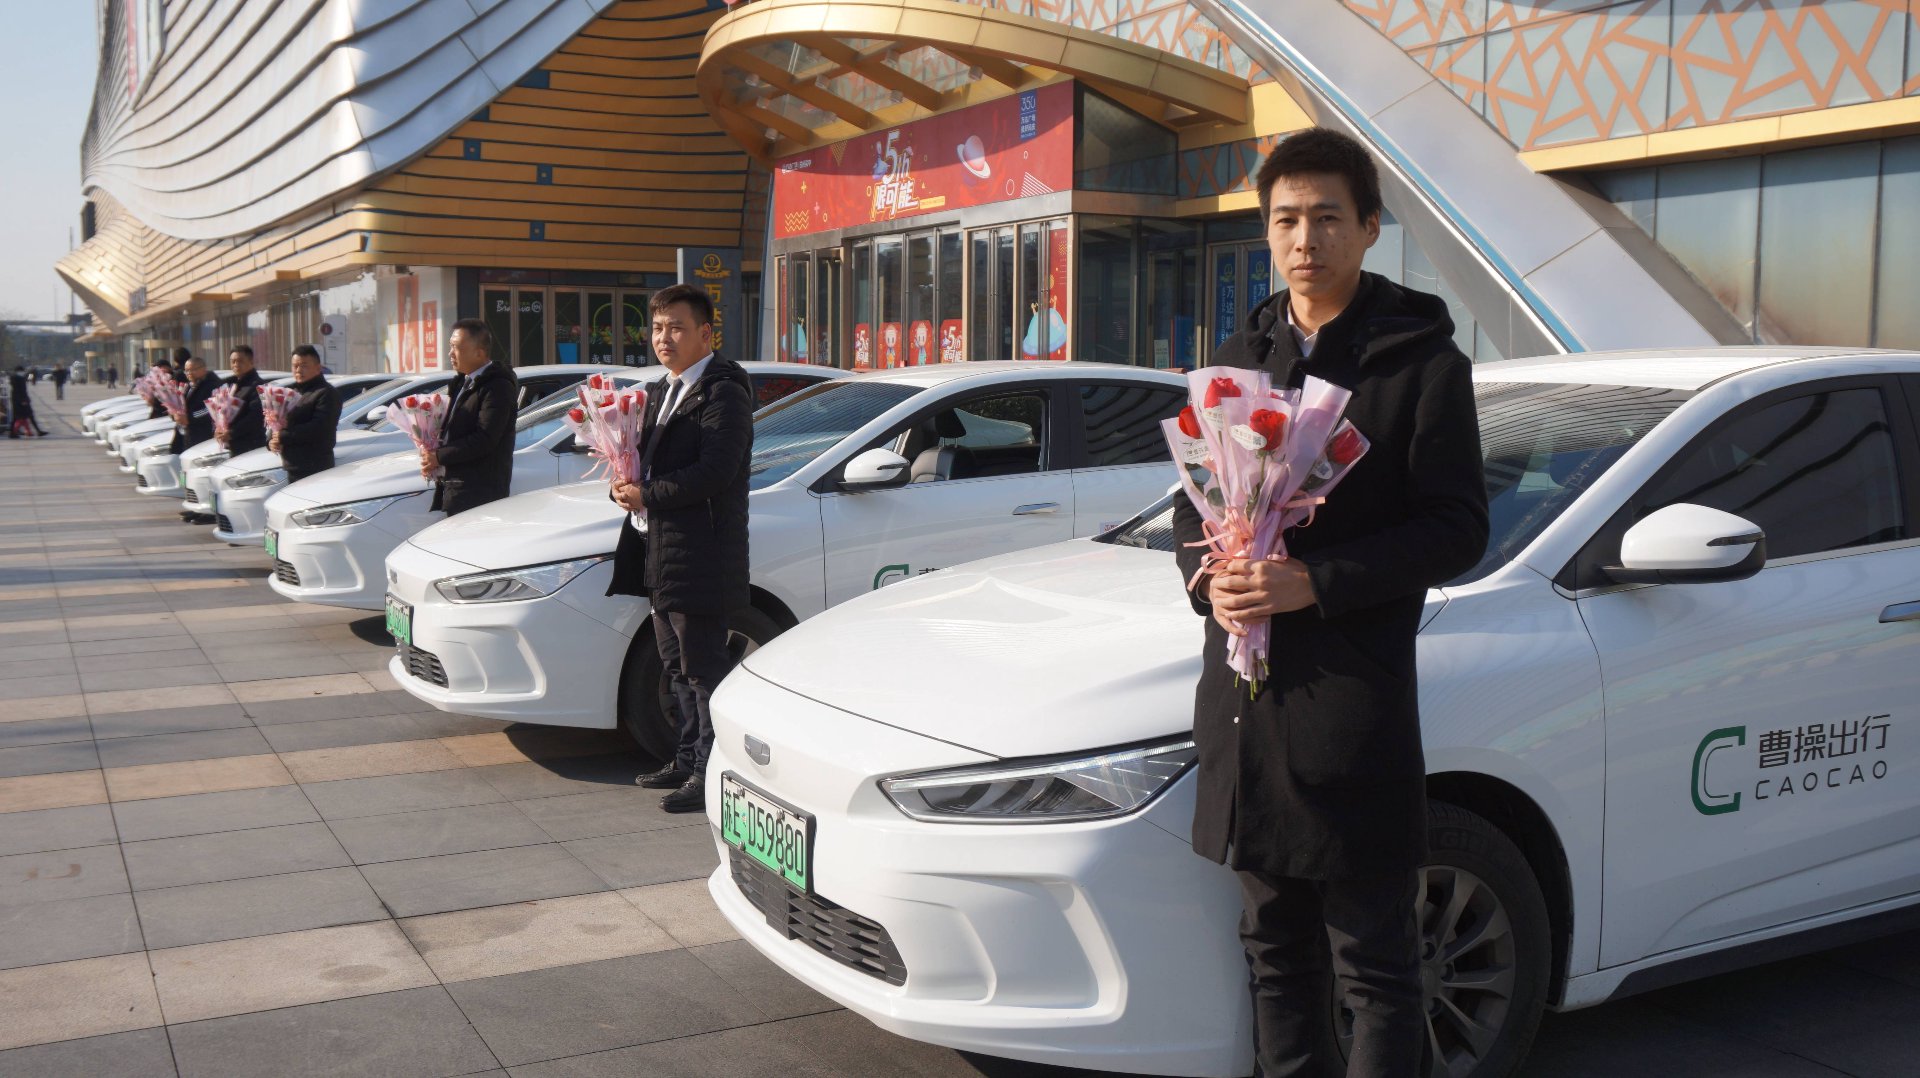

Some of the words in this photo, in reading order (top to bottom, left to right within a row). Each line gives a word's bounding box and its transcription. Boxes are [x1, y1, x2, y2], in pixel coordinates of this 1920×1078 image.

[1021, 96, 1036, 111] 350
[1758, 713, 1892, 769] 曹操出行
[1755, 760, 1888, 800] CAOCAO
